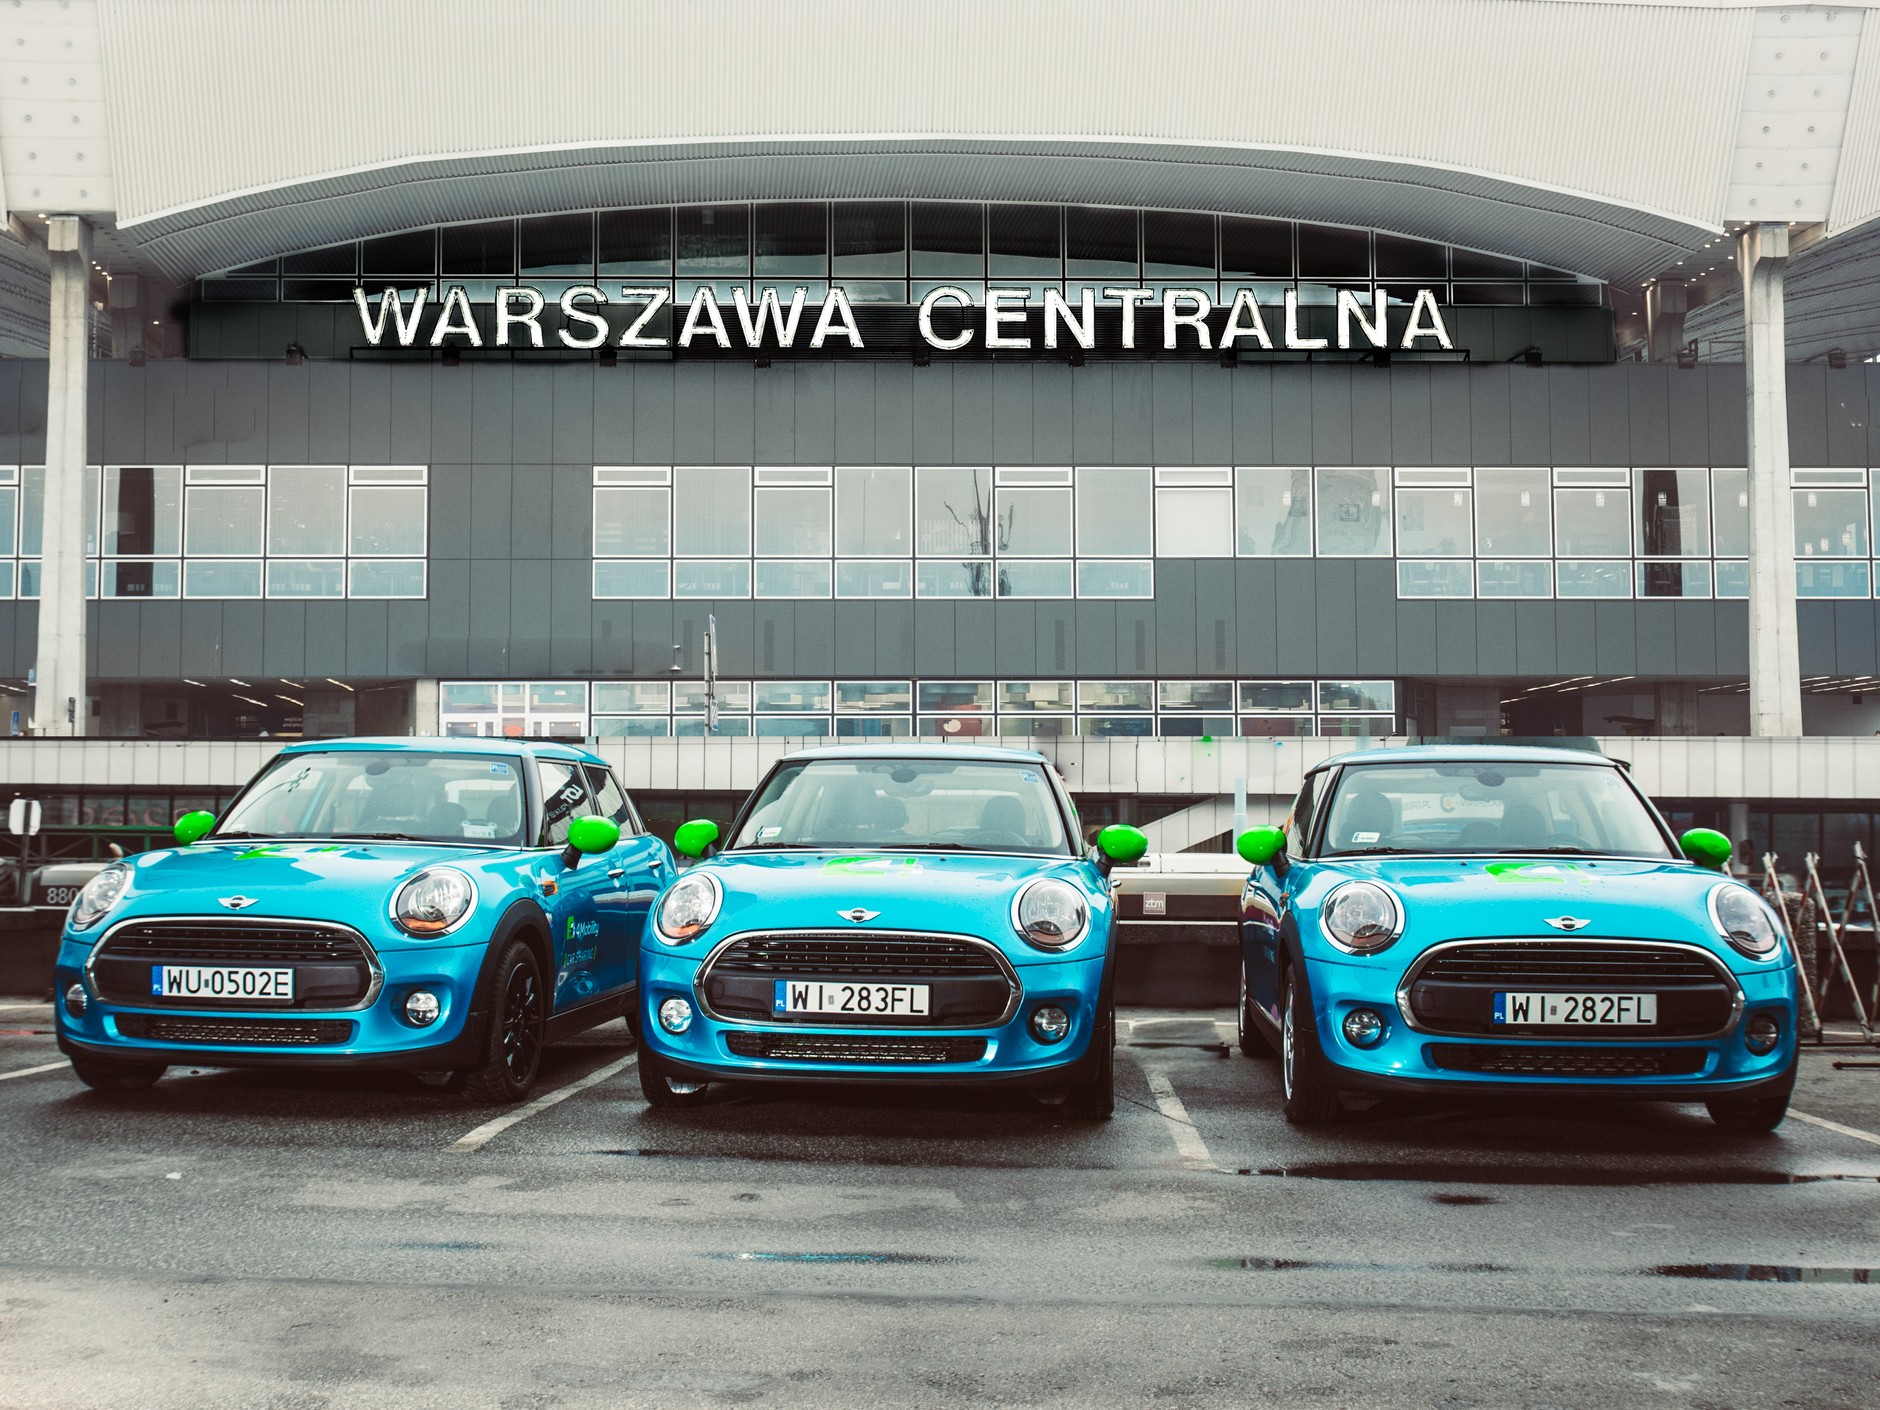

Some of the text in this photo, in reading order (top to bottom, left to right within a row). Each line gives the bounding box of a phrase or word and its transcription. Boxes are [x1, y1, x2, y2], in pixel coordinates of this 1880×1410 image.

[351, 284, 1456, 351] WARSZAWA CENTRALNA
[167, 969, 201, 994] WU
[211, 970, 289, 996] 0502E
[775, 984, 924, 1013] PL WI 283FL
[1494, 995, 1652, 1024] PL WI 282FL
